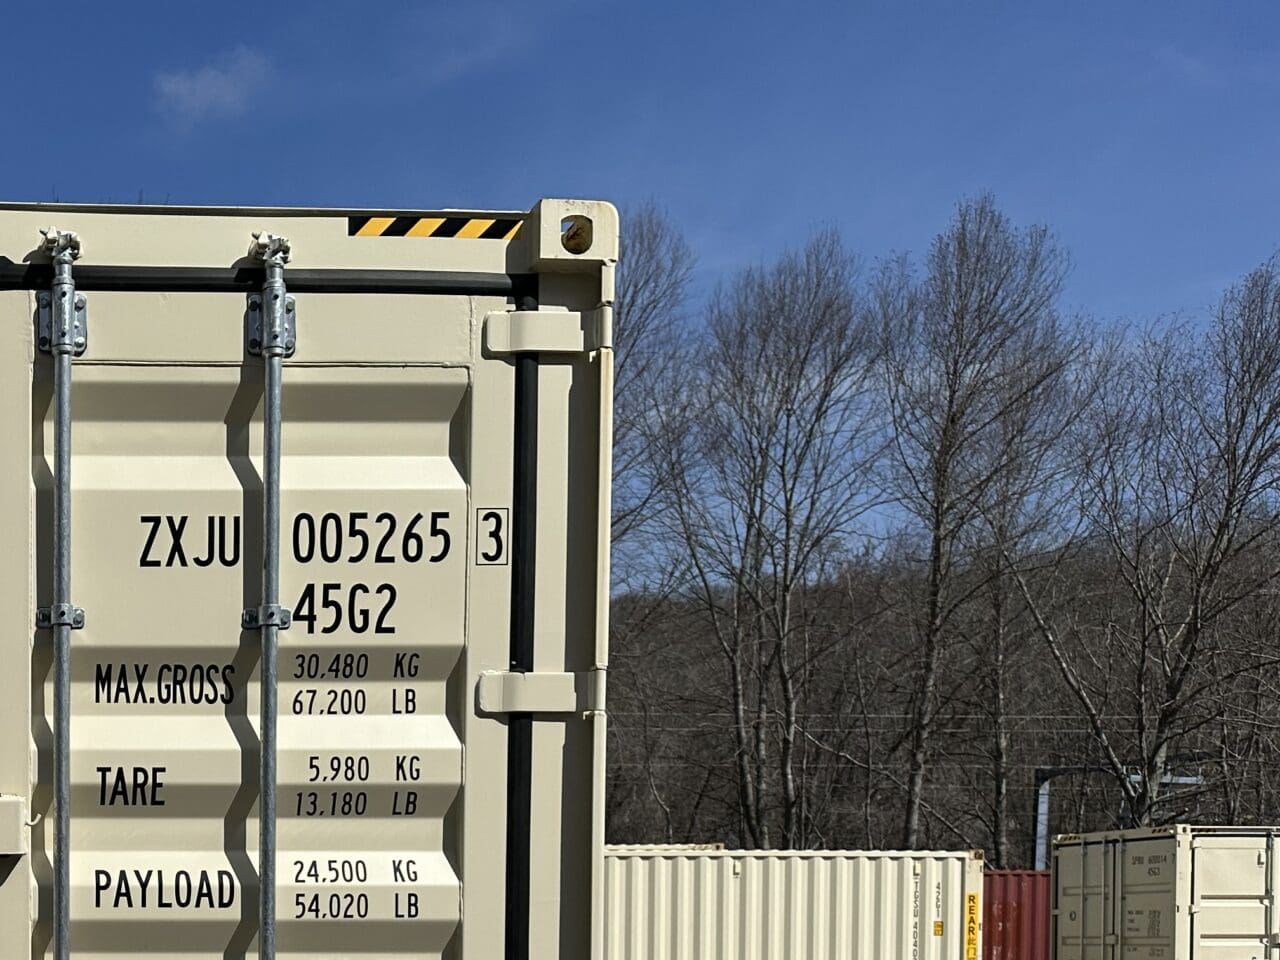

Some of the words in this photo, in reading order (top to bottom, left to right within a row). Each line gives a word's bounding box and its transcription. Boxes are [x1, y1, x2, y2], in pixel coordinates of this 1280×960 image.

[139, 515, 242, 568] ZXJU
[292, 511, 452, 564] 005265
[481, 511, 504, 563] 3
[292, 583, 397, 635] 45G2
[94, 663, 236, 705] MAX.GROSS
[393, 652, 420, 678] KG
[392, 688, 417, 714] LB
[96, 766, 167, 807] TARE
[395, 755, 421, 781] KG
[392, 791, 418, 815] LB
[94, 869, 236, 909] PAYLOAD
[392, 860, 418, 883] KG
[394, 892, 419, 918] LB
[967, 894, 976, 936] REAR
